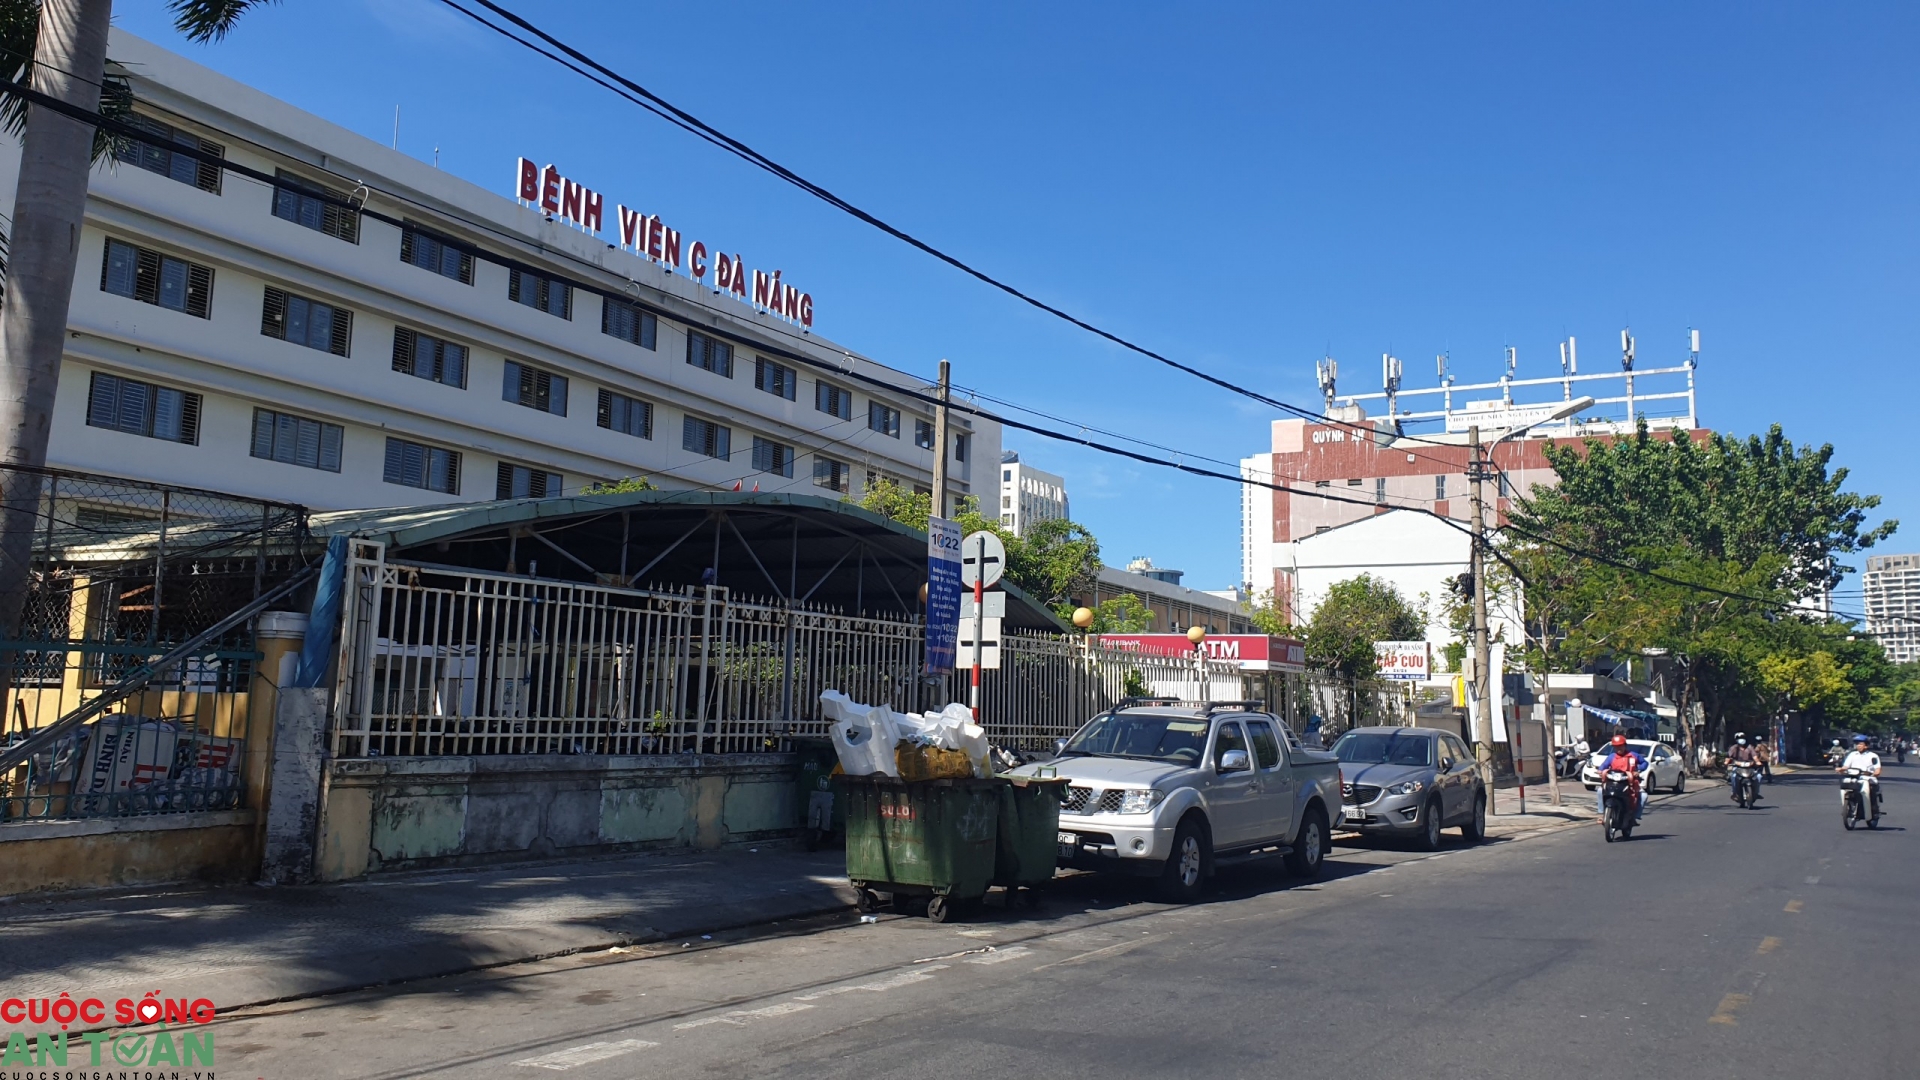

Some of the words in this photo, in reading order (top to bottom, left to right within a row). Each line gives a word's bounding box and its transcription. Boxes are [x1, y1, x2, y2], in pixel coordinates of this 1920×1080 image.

[516, 156, 603, 232] BỆNH
[617, 204, 681, 267] VIỆN
[688, 241, 707, 278] C
[714, 251, 746, 297] ĐÀ
[931, 533, 959, 551] 1022
[1197, 640, 1240, 659] ATM
[1401, 652, 1424, 668] CỨU
[881, 804, 910, 817] SULO
